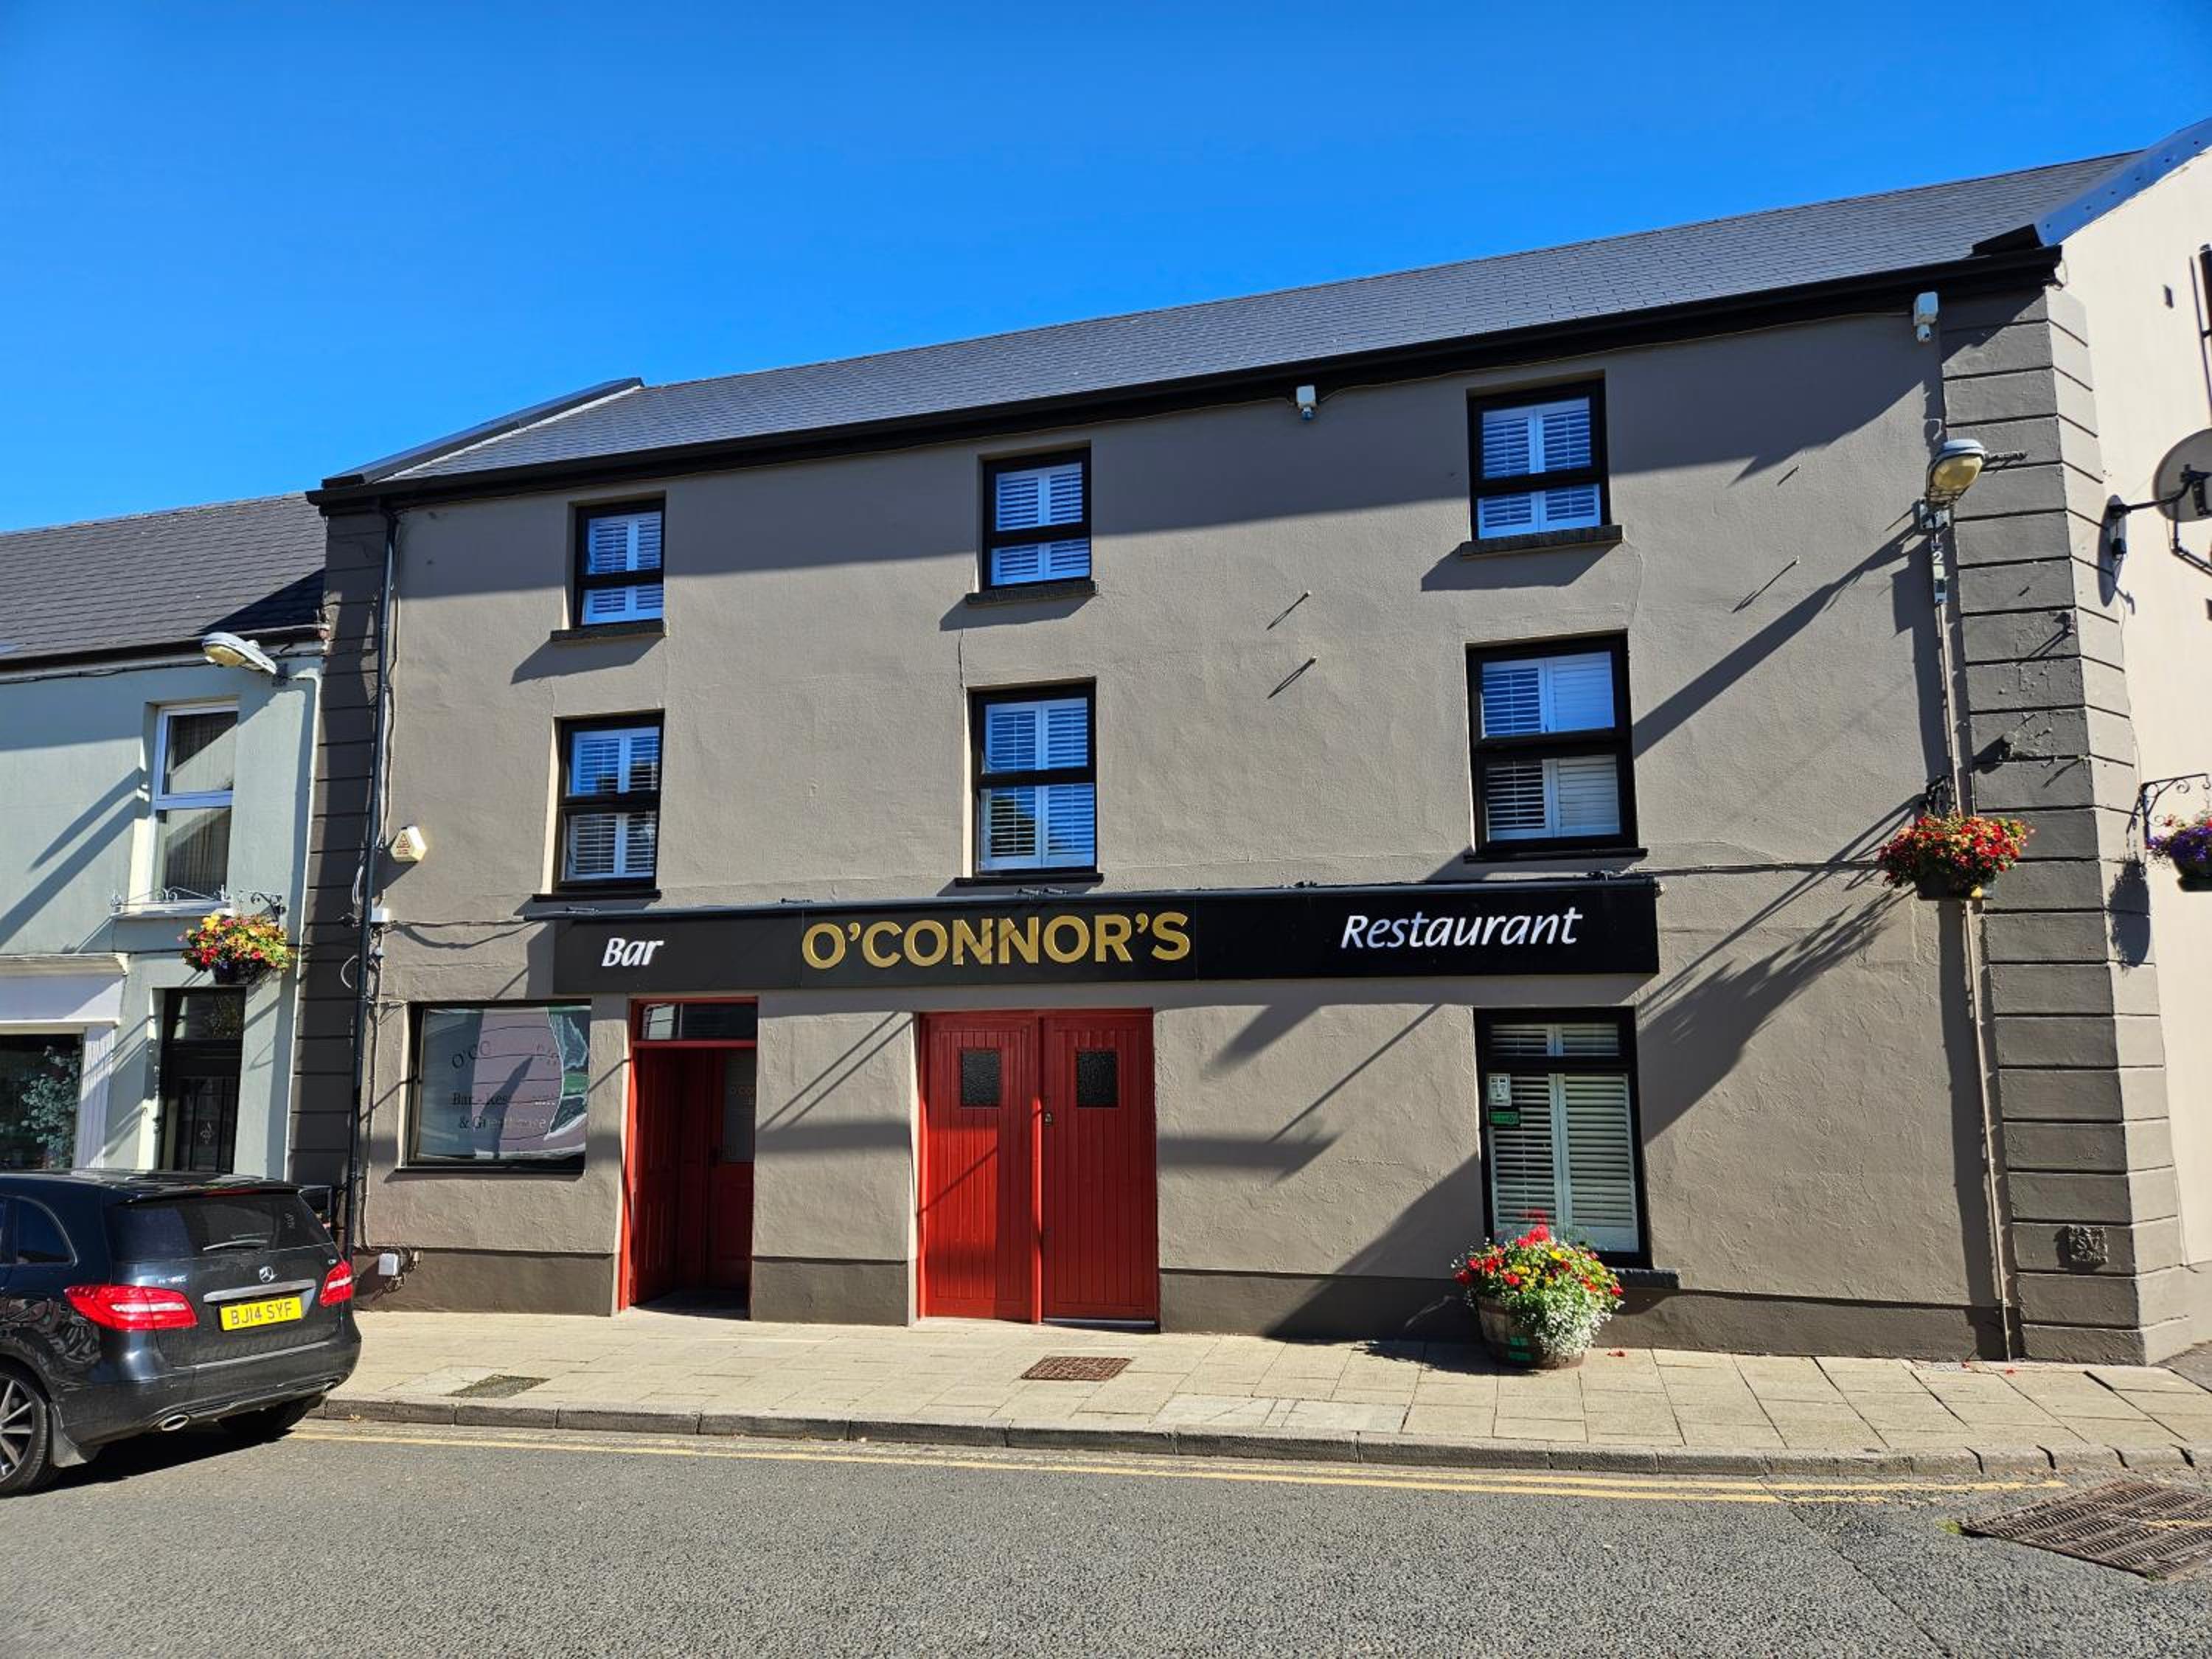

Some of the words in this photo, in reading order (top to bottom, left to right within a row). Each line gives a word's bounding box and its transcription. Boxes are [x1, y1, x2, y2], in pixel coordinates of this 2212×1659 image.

[1933, 551, 1944, 564] 2
[801, 913, 1192, 969] O'CONNOR'S
[1340, 906, 1583, 948] Restaurant
[601, 937, 665, 967] Bar
[231, 1306, 262, 1326] BJ14
[266, 1301, 292, 1320] SYF
